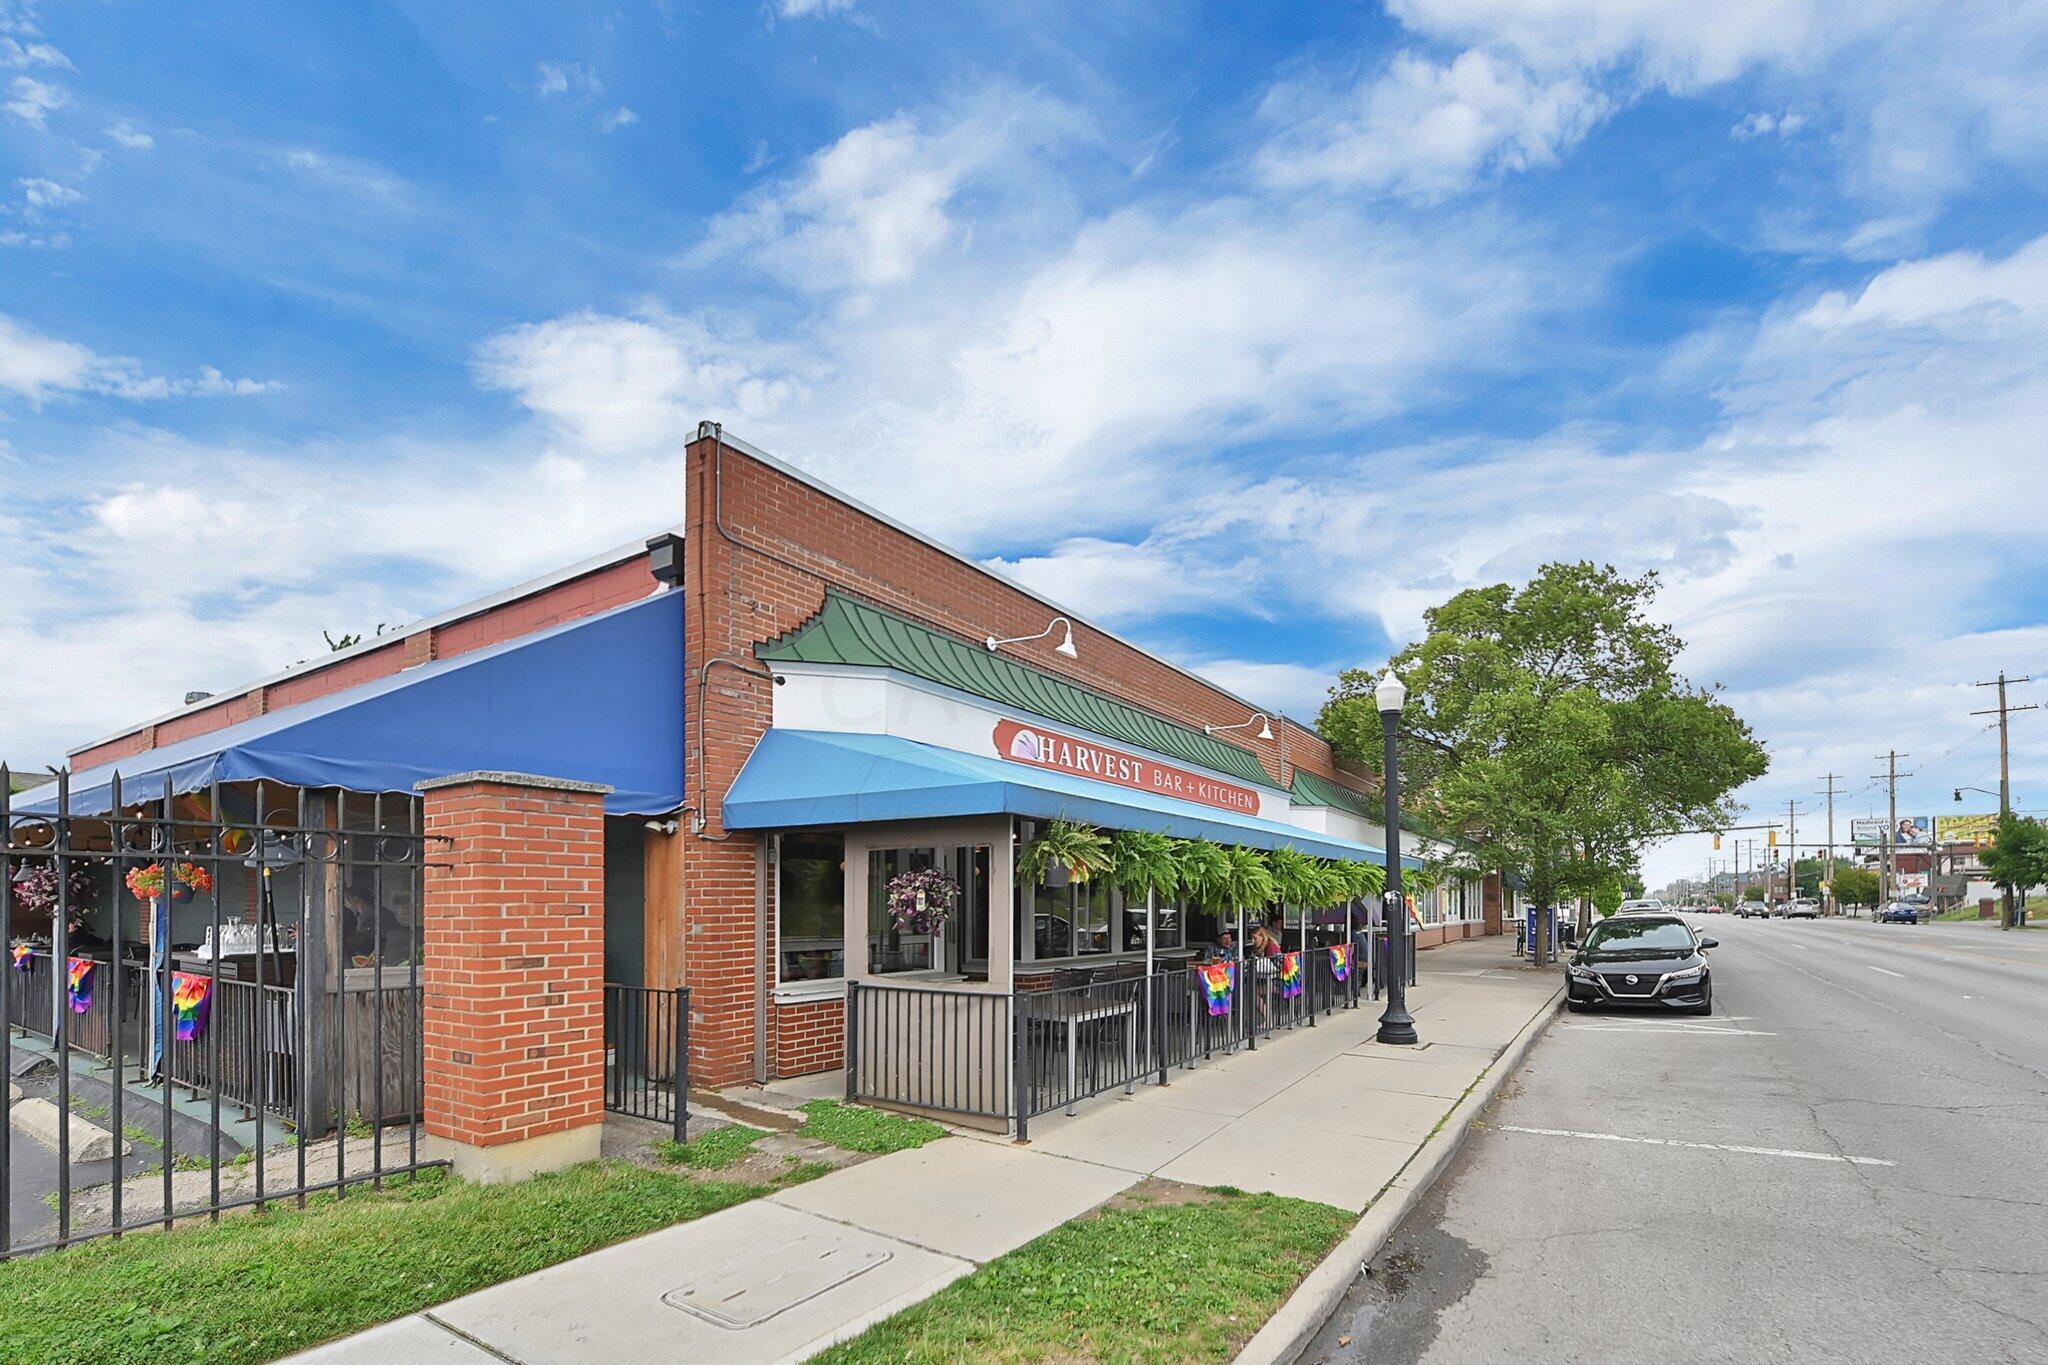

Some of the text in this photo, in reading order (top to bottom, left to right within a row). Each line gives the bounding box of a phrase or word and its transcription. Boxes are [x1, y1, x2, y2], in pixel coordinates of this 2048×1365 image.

[1035, 735, 1253, 809] HARVEST BAR + KITCHEN
